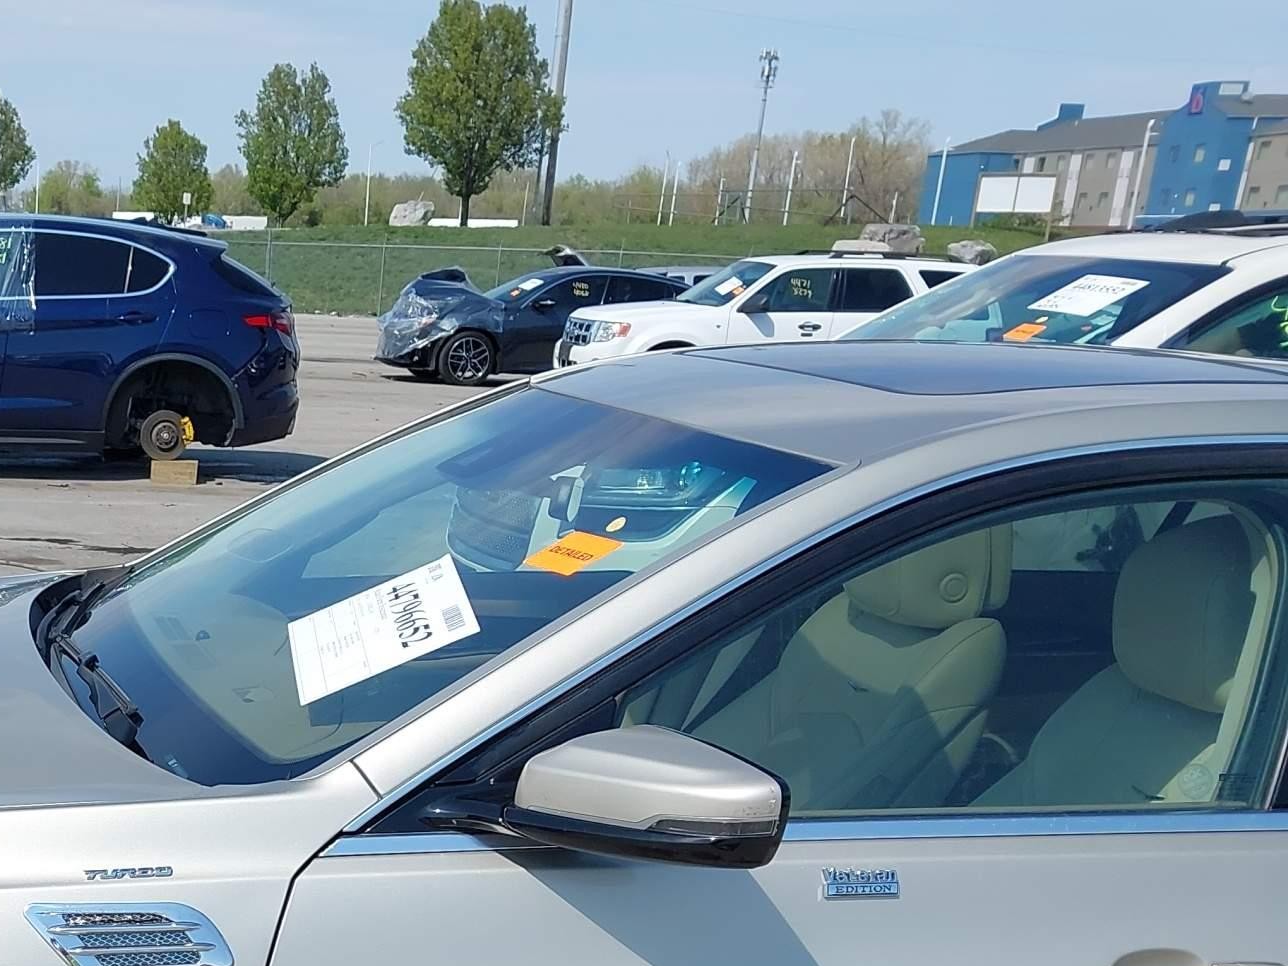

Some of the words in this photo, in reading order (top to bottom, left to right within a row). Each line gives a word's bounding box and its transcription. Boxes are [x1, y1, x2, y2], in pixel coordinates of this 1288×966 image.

[549, 546, 593, 561] DETAILED
[387, 582, 433, 649] 44796652
[83, 867, 174, 881] TURBO
[835, 885, 892, 894] EDITION
